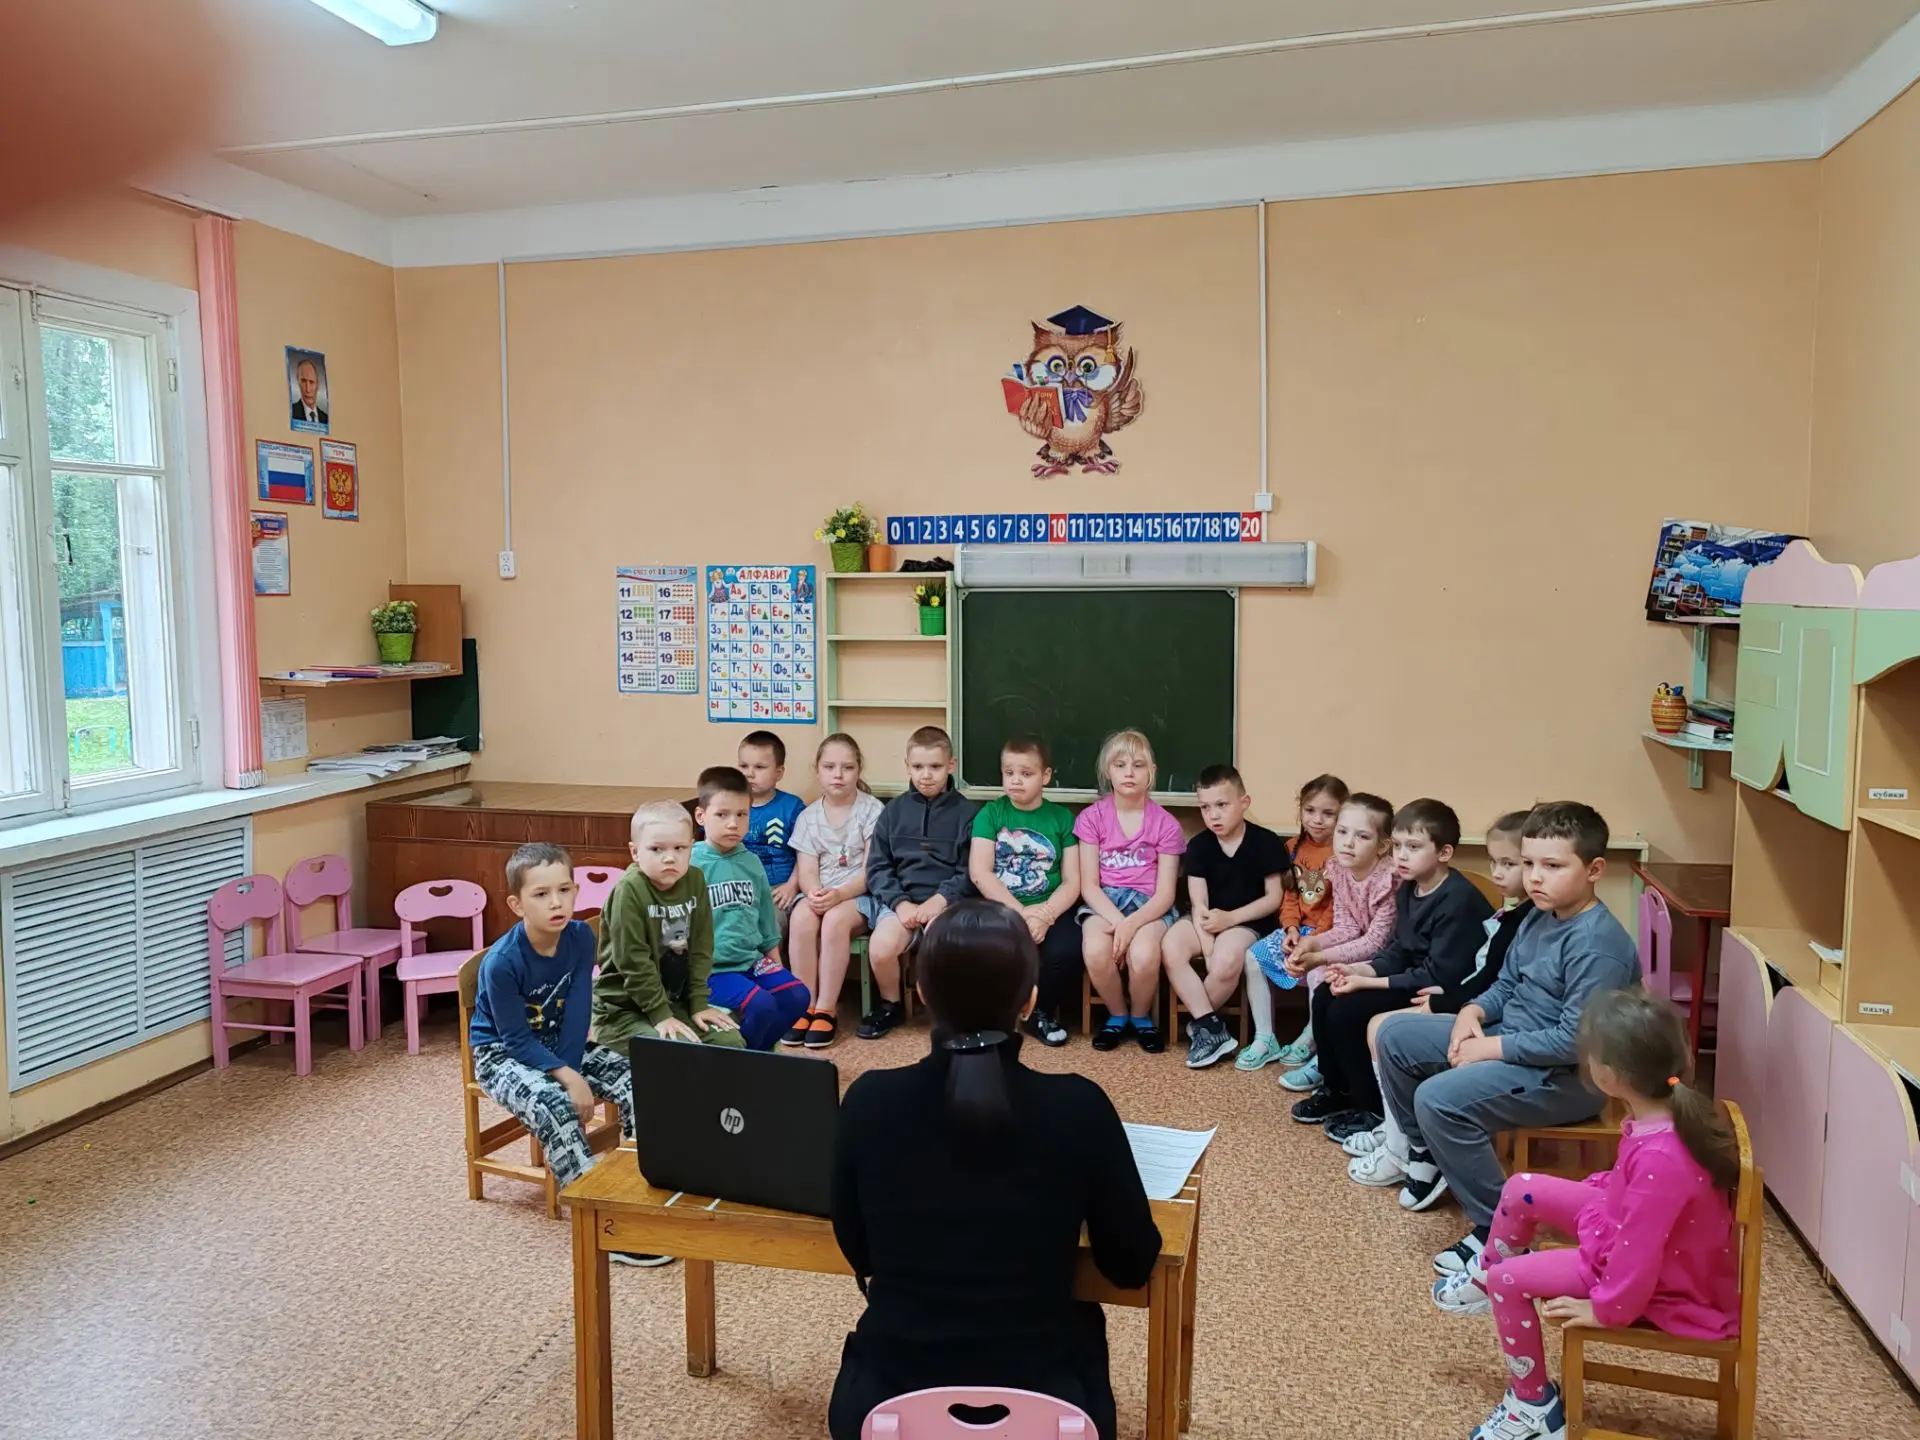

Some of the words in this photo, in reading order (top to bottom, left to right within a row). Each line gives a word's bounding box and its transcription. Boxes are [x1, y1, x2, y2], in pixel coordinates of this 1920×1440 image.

[891, 522, 900, 540] 0
[907, 522, 915, 540] 1
[923, 521, 932, 540] 2
[939, 521, 947, 540] 3
[954, 520, 964, 539] 4
[970, 520, 979, 539] 5
[986, 520, 996, 538] 6
[1003, 520, 1012, 538] 7
[1020, 519, 1029, 538] 8
[1036, 519, 1045, 538] 9
[1051, 519, 1066, 538] 10
[1070, 519, 1084, 538] 11
[1088, 519, 1104, 538] 12
[1108, 518, 1122, 538] 13
[1127, 518, 1143, 538] 14
[1146, 518, 1161, 538] 15
[1165, 518, 1181, 537] 16
[1184, 518, 1200, 537] 17
[1204, 518, 1220, 537] 18
[1223, 518, 1240, 537] 19
[1242, 517, 1260, 537] 20
[740, 570, 788, 580] АЛФАВИТ
[620, 588, 631, 597] 11
[658, 588, 671, 597] 16
[794, 604, 810, 614] Жж
[620, 610, 632, 619] 12
[659, 610, 671, 619] 17
[621, 631, 633, 641] 13
[659, 632, 671, 641] 18
[621, 653, 634, 662] 14
[660, 653, 672, 663] 19
[621, 674, 634, 684] 15
[661, 674, 674, 684] 20
[707, 880, 754, 909] ILDNESS
[668, 904, 685, 918] BUT
[722, 1107, 743, 1134] hp
[604, 1219, 616, 1236] 2
